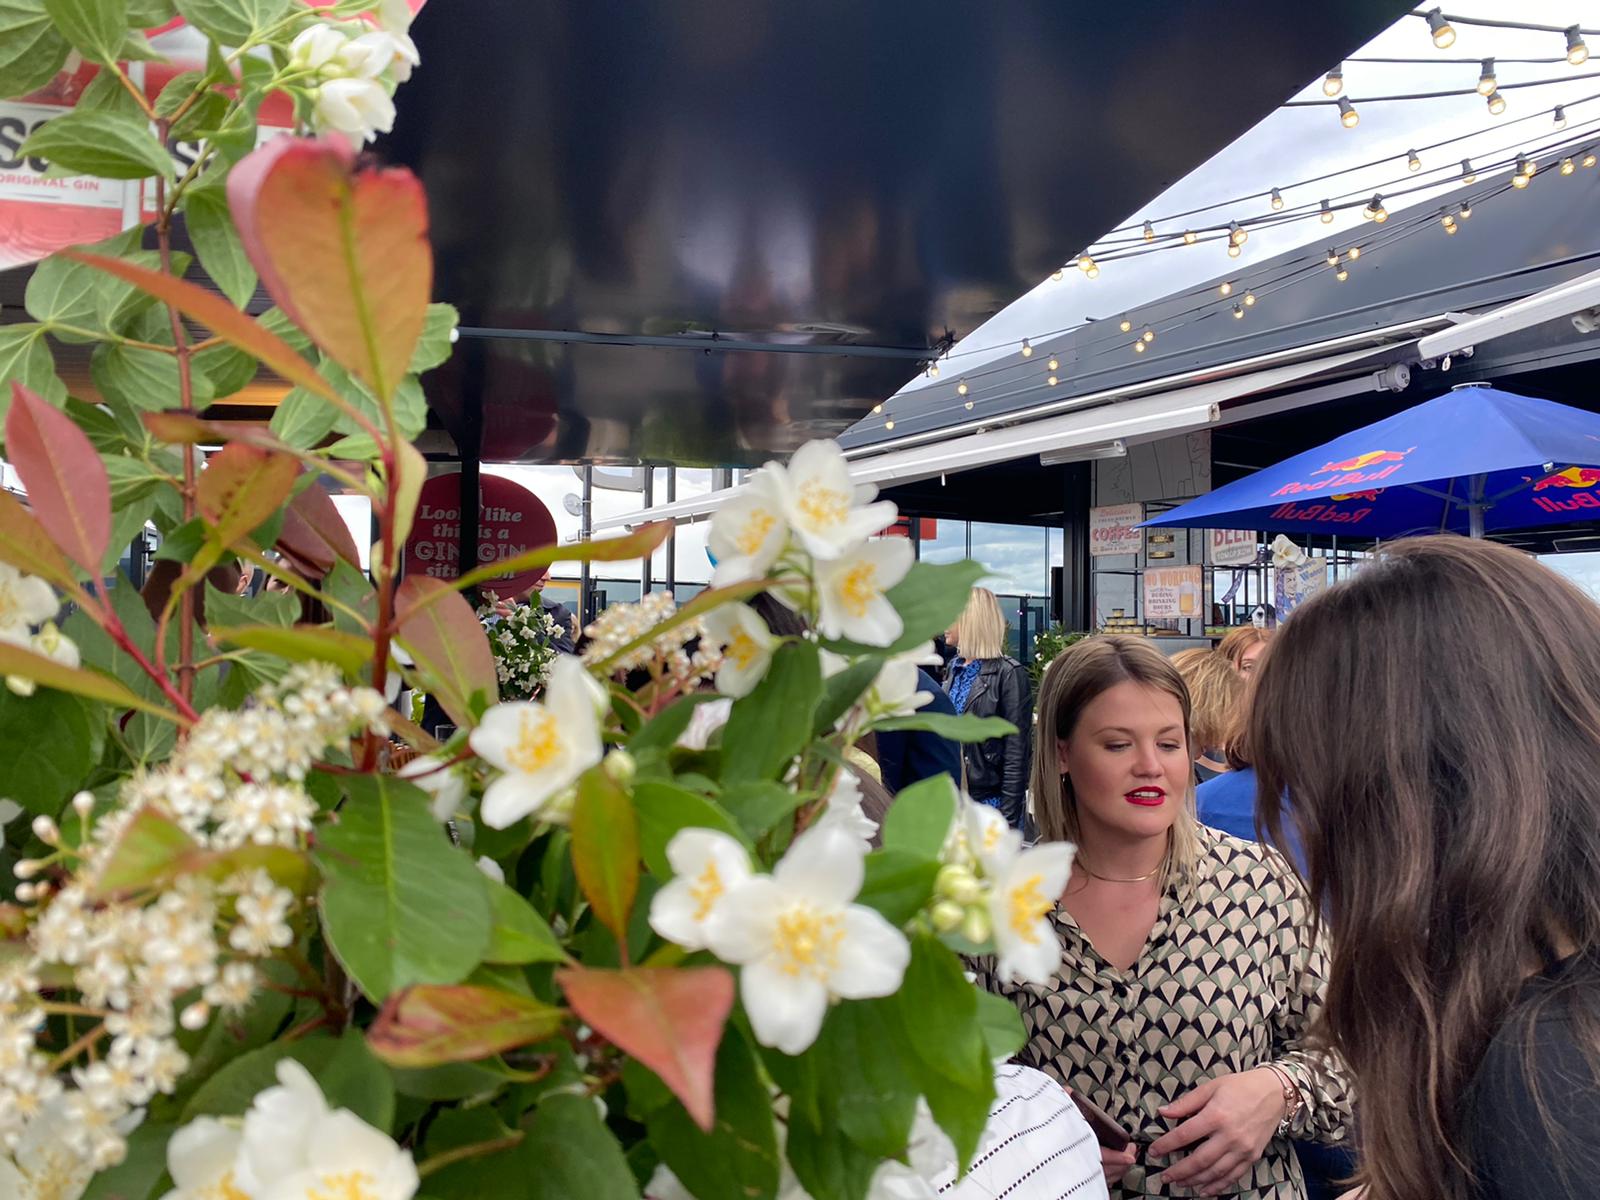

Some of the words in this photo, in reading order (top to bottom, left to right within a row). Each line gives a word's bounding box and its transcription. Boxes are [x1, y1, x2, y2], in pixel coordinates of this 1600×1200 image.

[73, 180, 100, 191] GIN
[485, 507, 522, 522] like
[433, 523, 464, 538] thi
[497, 529, 510, 540] a
